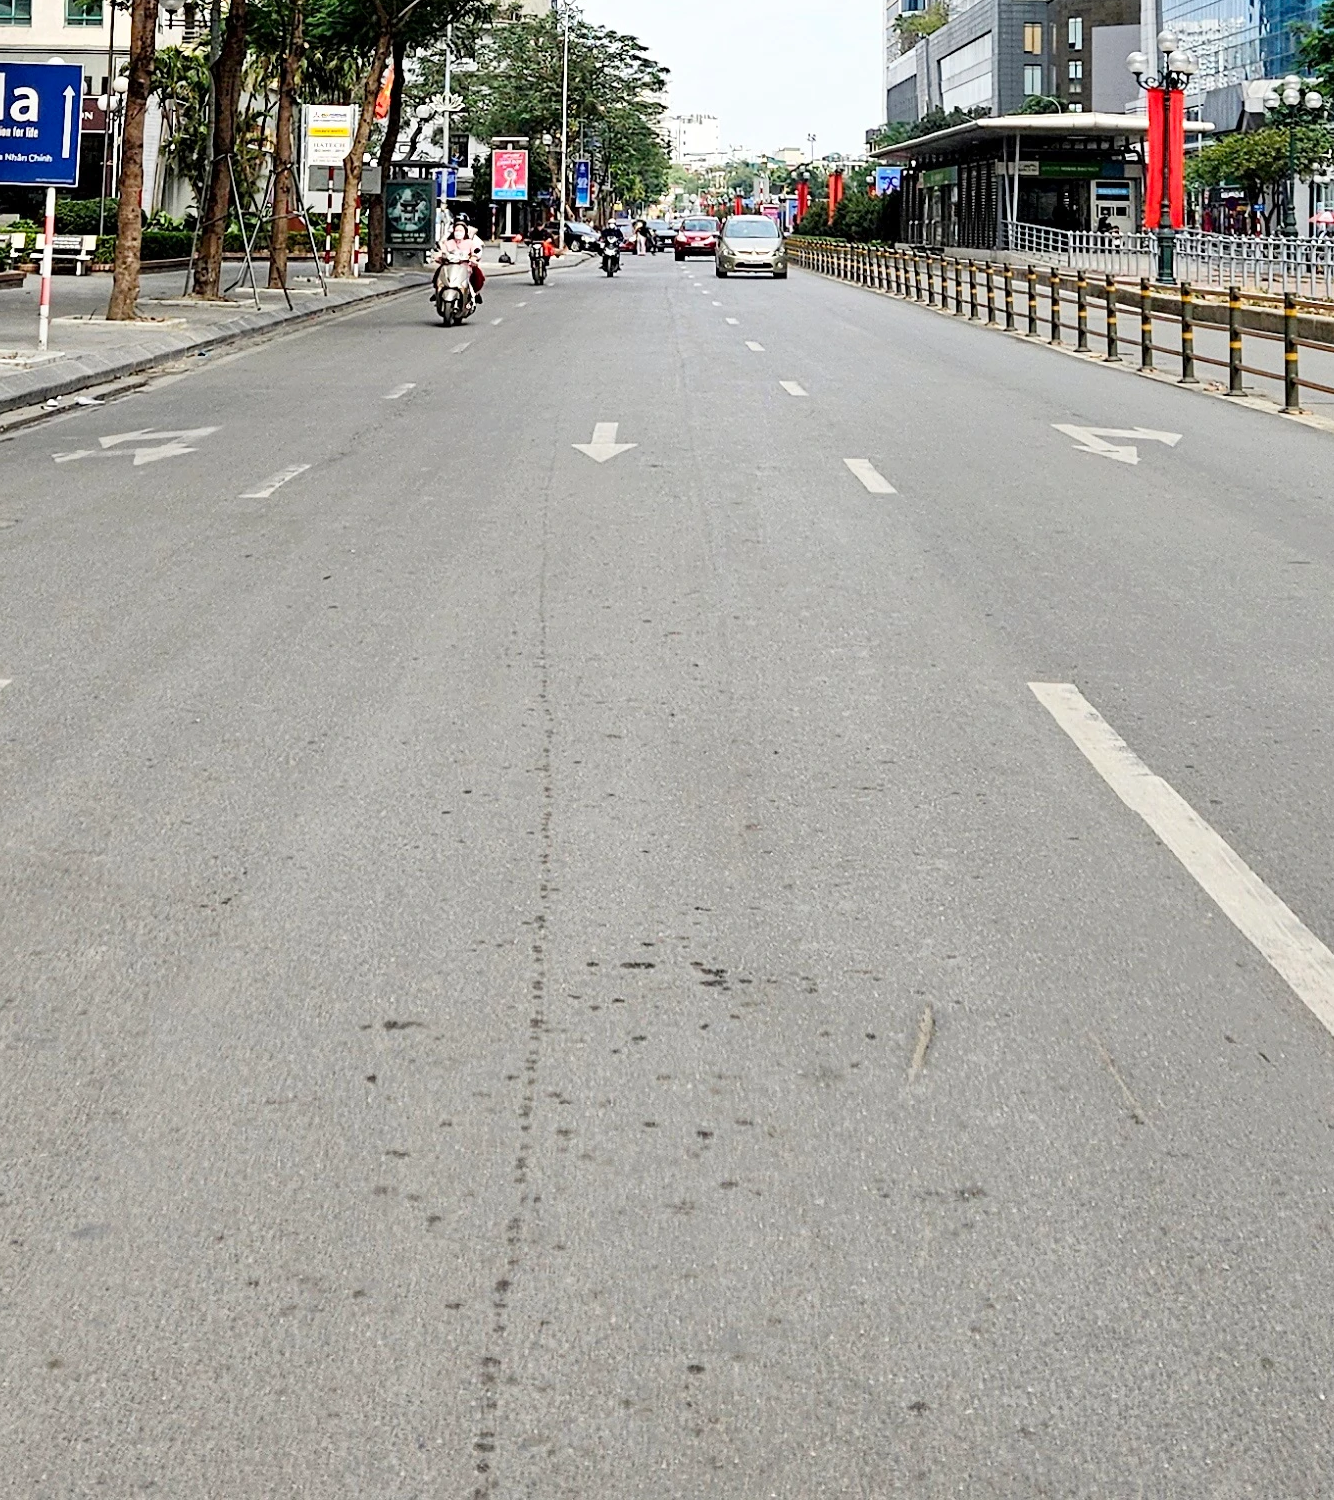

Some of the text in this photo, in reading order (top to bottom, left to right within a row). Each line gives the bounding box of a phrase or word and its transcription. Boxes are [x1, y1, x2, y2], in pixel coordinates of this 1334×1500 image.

[12, 125, 24, 138] for
[25, 126, 39, 139] life
[4, 152, 28, 162] Nhân
[28, 153, 53, 163] Chính
